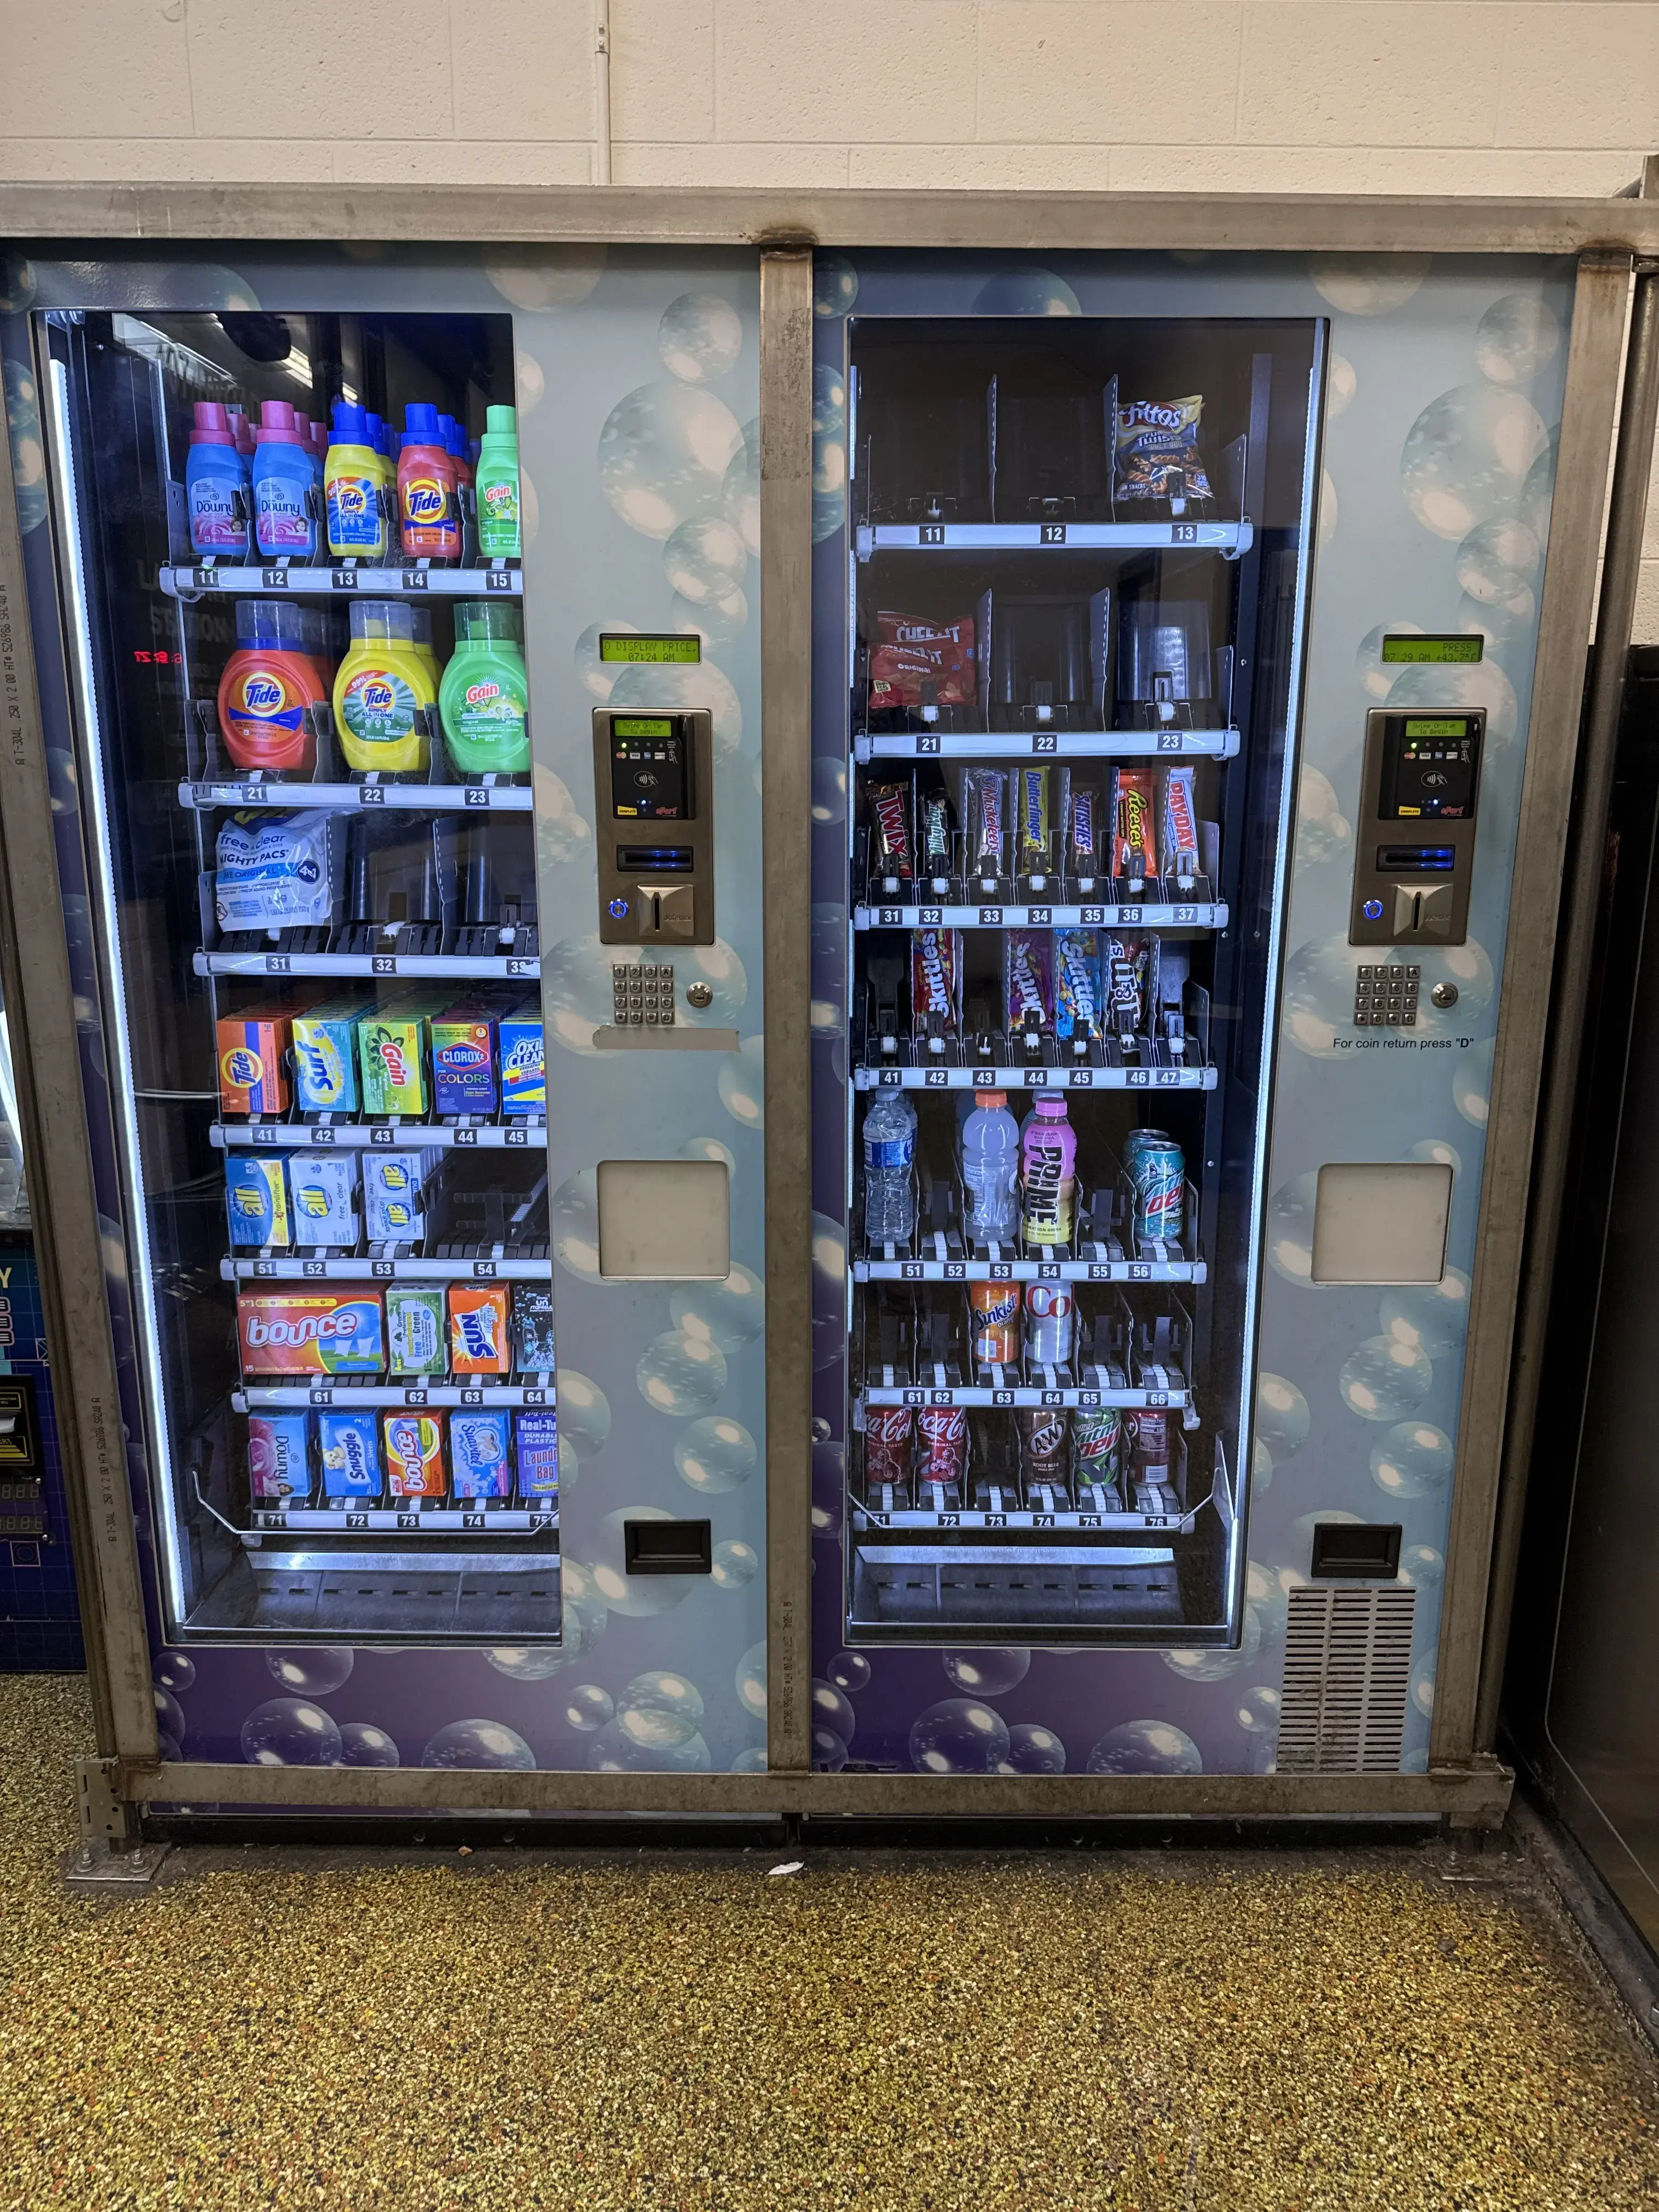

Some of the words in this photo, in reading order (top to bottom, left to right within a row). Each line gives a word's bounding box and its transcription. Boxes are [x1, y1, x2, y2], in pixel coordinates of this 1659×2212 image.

[486, 486, 510, 501] Gain
[341, 492, 363, 510] Tide
[408, 490, 442, 517] Tide
[196, 500, 234, 516] Downy
[261, 500, 300, 516] Downy
[926, 528, 940, 541] 11
[1046, 528, 1062, 540] 12
[1177, 527, 1193, 539] 13
[199, 571, 215, 584] 11
[268, 572, 284, 584] 12
[337, 572, 353, 585] 13
[408, 573, 424, 586] 14
[492, 573, 507, 586] 15
[616, 642, 657, 651] DISPLAY
[1442, 642, 1471, 652] PRESS
[628, 653, 657, 662] 07:24
[663, 653, 675, 662] AM
[1419, 653, 1430, 662] AM
[246, 683, 281, 708] Tide
[364, 687, 393, 706] Tide
[467, 682, 499, 704] Gain
[922, 739, 937, 751] 21
[1037, 737, 1053, 750] 22
[1163, 736, 1179, 748] 23
[248, 787, 263, 800] 21
[364, 789, 381, 802] 22
[470, 791, 486, 803] 23
[1025, 771, 1043, 843] Butterfinger
[981, 787, 1001, 855] Musketeers
[1126, 788, 1149, 849] Reese's
[1170, 781, 1197, 850] PAYDAY
[1075, 795, 1092, 849] SATISFIES
[220, 834, 249, 850] free
[256, 835, 286, 849] clear
[235, 867, 275, 878] ORIGINAL
[884, 911, 899, 922] 31
[923, 911, 939, 922] 32
[984, 910, 1000, 922] 33
[1032, 910, 1048, 922] 34
[1085, 910, 1101, 922] 35
[1123, 909, 1139, 921] 36
[1178, 908, 1194, 920] 37
[271, 958, 286, 969] 31
[376, 959, 393, 971] 32
[1333, 1038, 1353, 1048] For
[1356, 1039, 1379, 1048] coin
[1383, 1039, 1418, 1048] return
[1420, 1040, 1452, 1050] press
[1455, 1037, 1474, 1048] "D"
[443, 1051, 480, 1063] CLOROX
[507, 1049, 545, 1070] CLEAN
[232, 1051, 258, 1085] Tide
[296, 1040, 334, 1091] Surf
[380, 1042, 407, 1087] Gain
[438, 1074, 490, 1084] COLORS
[884, 1072, 898, 1084] 41
[929, 1073, 945, 1084] 42
[977, 1073, 992, 1084] 43
[1029, 1073, 1044, 1084] 44
[1074, 1073, 1089, 1084] 45
[1131, 1072, 1146, 1084] 46
[1161, 1072, 1176, 1084] 47
[258, 1130, 273, 1141] 41
[315, 1130, 332, 1141] 42
[375, 1131, 391, 1142] 43
[458, 1131, 474, 1143] 44
[509, 1131, 524, 1143] 45
[382, 1164, 408, 1189] all
[1026, 1144, 1062, 1225] PRIME
[234, 1187, 265, 1216] all
[297, 1187, 329, 1217] all
[386, 1204, 410, 1226] all
[258, 1262, 273, 1274] 51
[307, 1263, 323, 1274] 52
[376, 1263, 392, 1274] 53
[478, 1263, 493, 1275] 54
[906, 1265, 920, 1276] 51
[948, 1266, 963, 1277] 52
[994, 1266, 1009, 1277] 53
[1042, 1266, 1058, 1277] 54
[1093, 1266, 1108, 1277] 55
[1133, 1266, 1148, 1277] 56
[974, 1293, 1017, 1330] Sunkist
[247, 1313, 358, 1348] bounce
[461, 1313, 497, 1358] SUN
[414, 1341, 422, 1357] Free
[314, 1392, 329, 1403] 61
[409, 1391, 424, 1403] 62
[465, 1391, 480, 1403] 63
[527, 1391, 542, 1403] 64
[908, 1392, 921, 1403] 61
[935, 1392, 950, 1403] 62
[997, 1392, 1012, 1403] 63
[1046, 1393, 1060, 1404] 64
[1083, 1393, 1098, 1404] 65
[1150, 1393, 1166, 1404] 66
[1077, 1422, 1095, 1431] diet
[461, 1424, 482, 1465] Suavitel
[1034, 1423, 1063, 1455] A&W
[274, 1435, 289, 1480] Downy
[346, 1432, 365, 1480] Snuggle
[395, 1429, 427, 1491] bounce
[537, 1465, 554, 1480] Bag
[269, 1515, 283, 1526] 71
[350, 1515, 365, 1526] 72
[401, 1516, 416, 1526] 73
[467, 1516, 482, 1526] 74
[942, 1516, 956, 1526] 72
[989, 1516, 1003, 1526] 73
[1037, 1517, 1052, 1526] 74
[1083, 1517, 1097, 1526] 75
[1150, 1517, 1164, 1526] 76
